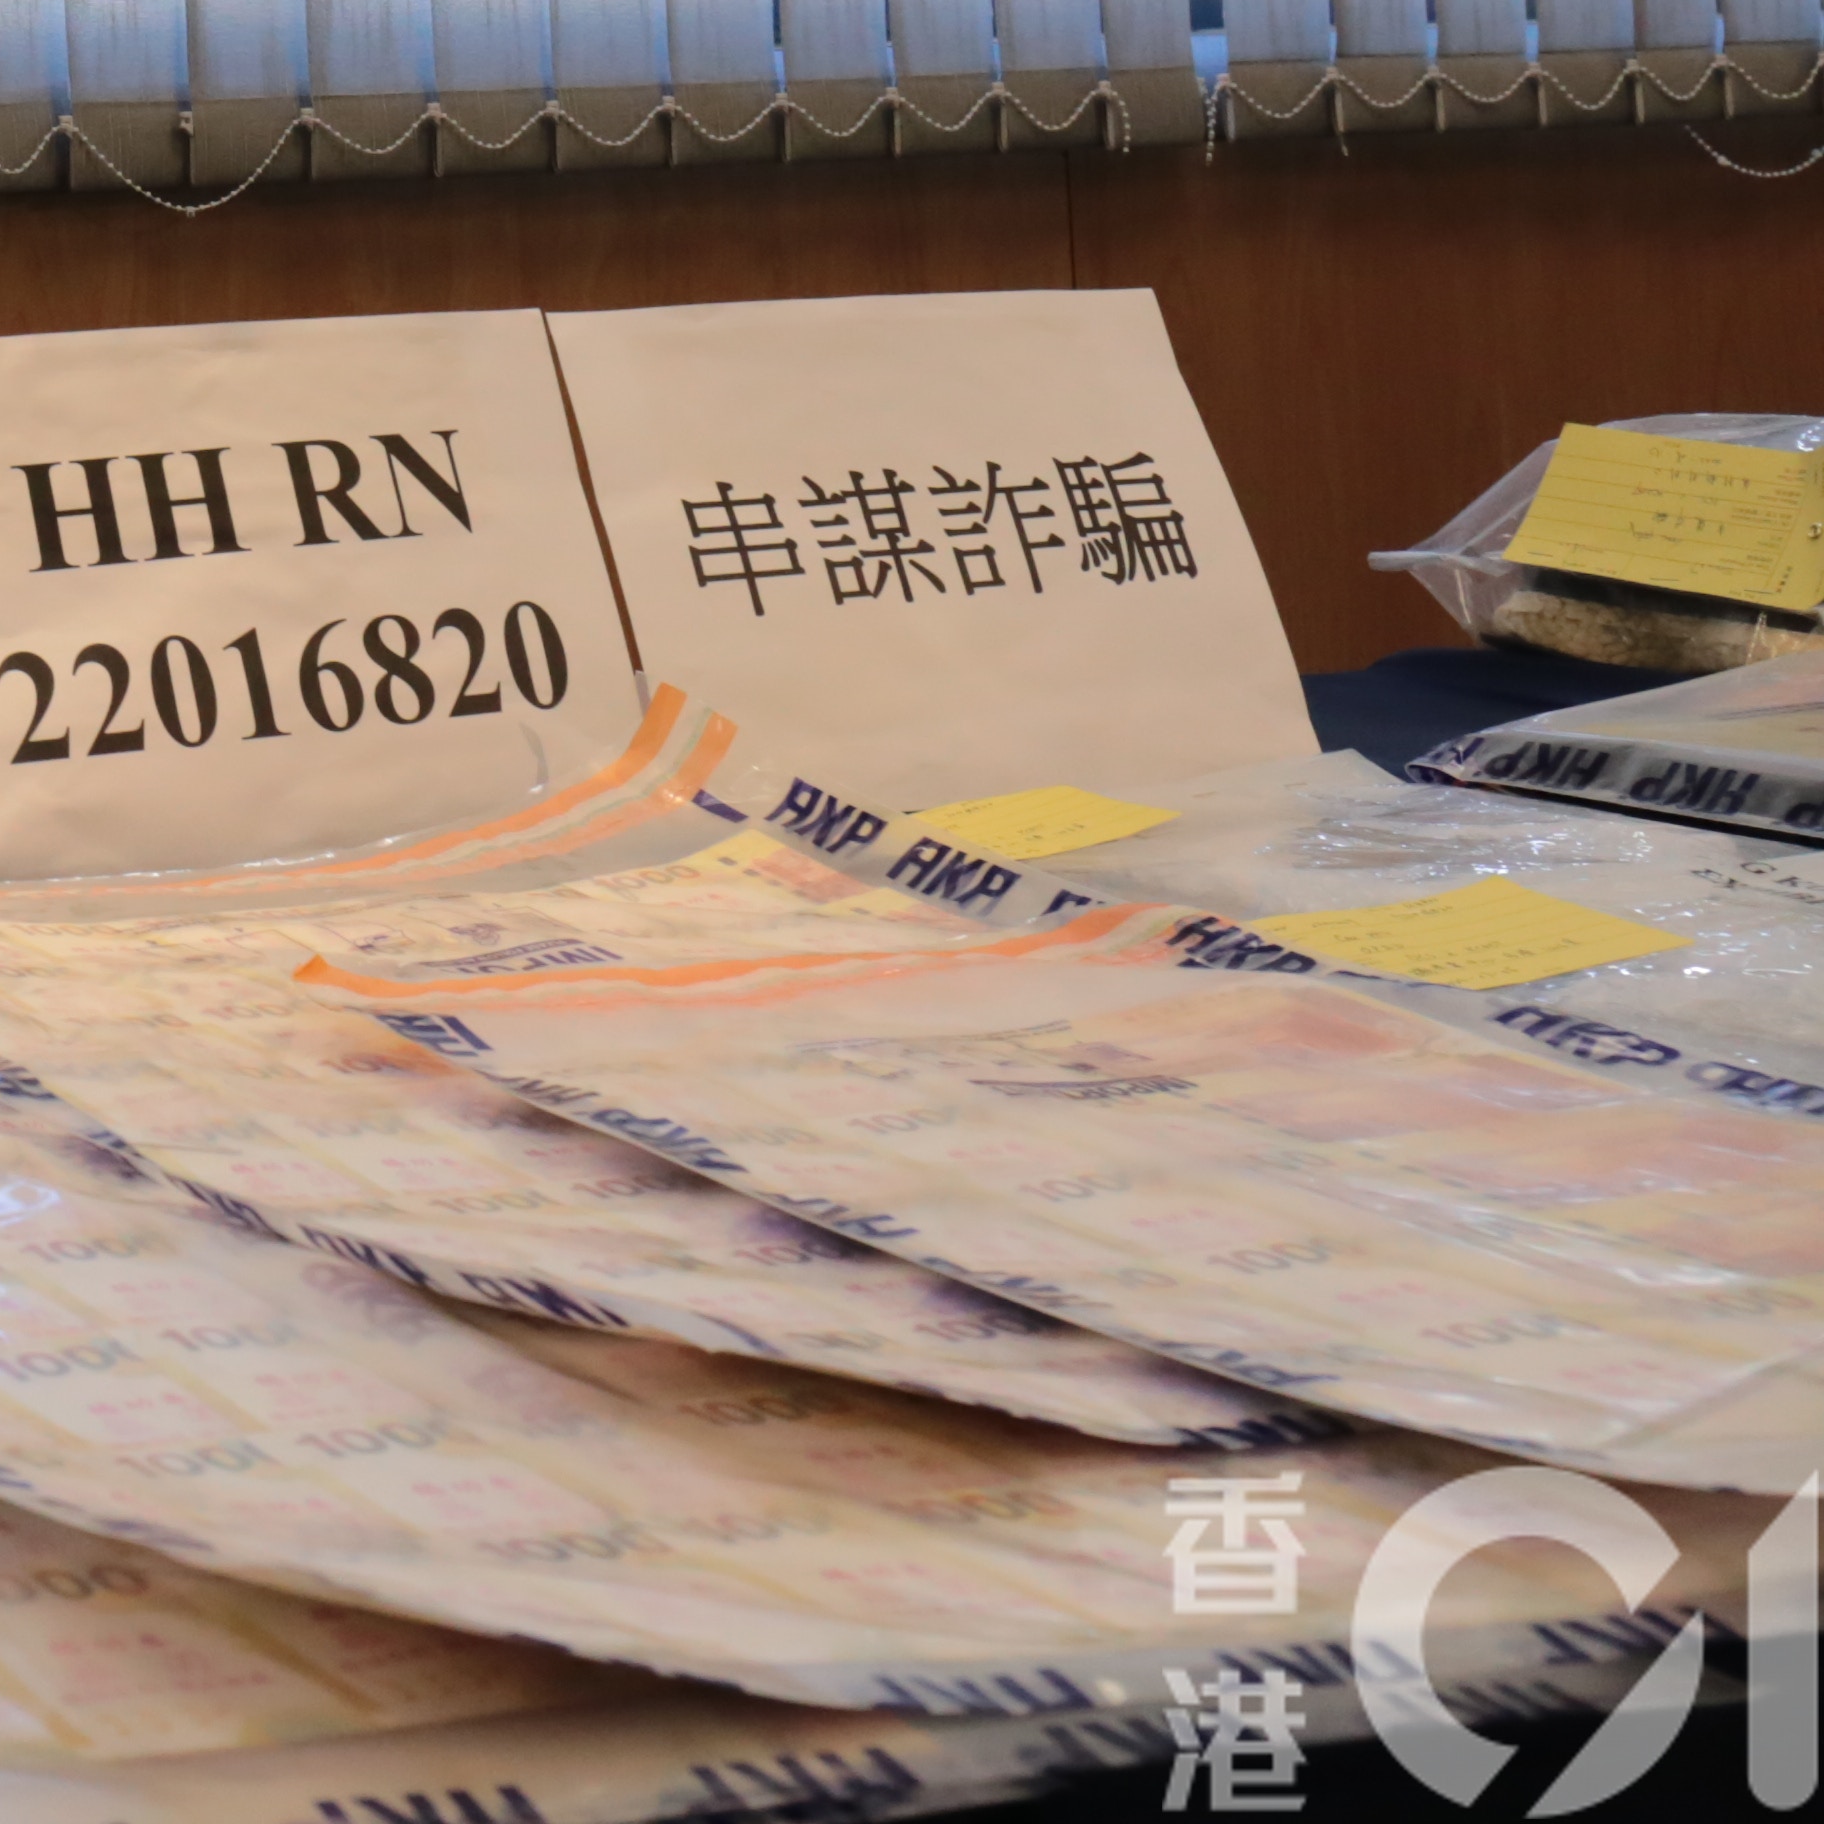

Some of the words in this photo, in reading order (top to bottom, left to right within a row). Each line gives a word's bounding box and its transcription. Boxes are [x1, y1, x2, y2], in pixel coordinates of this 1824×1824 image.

[10, 446, 252, 573] HH
[271, 429, 474, 547] RN
[680, 452, 1198, 616] 串謀詐騙
